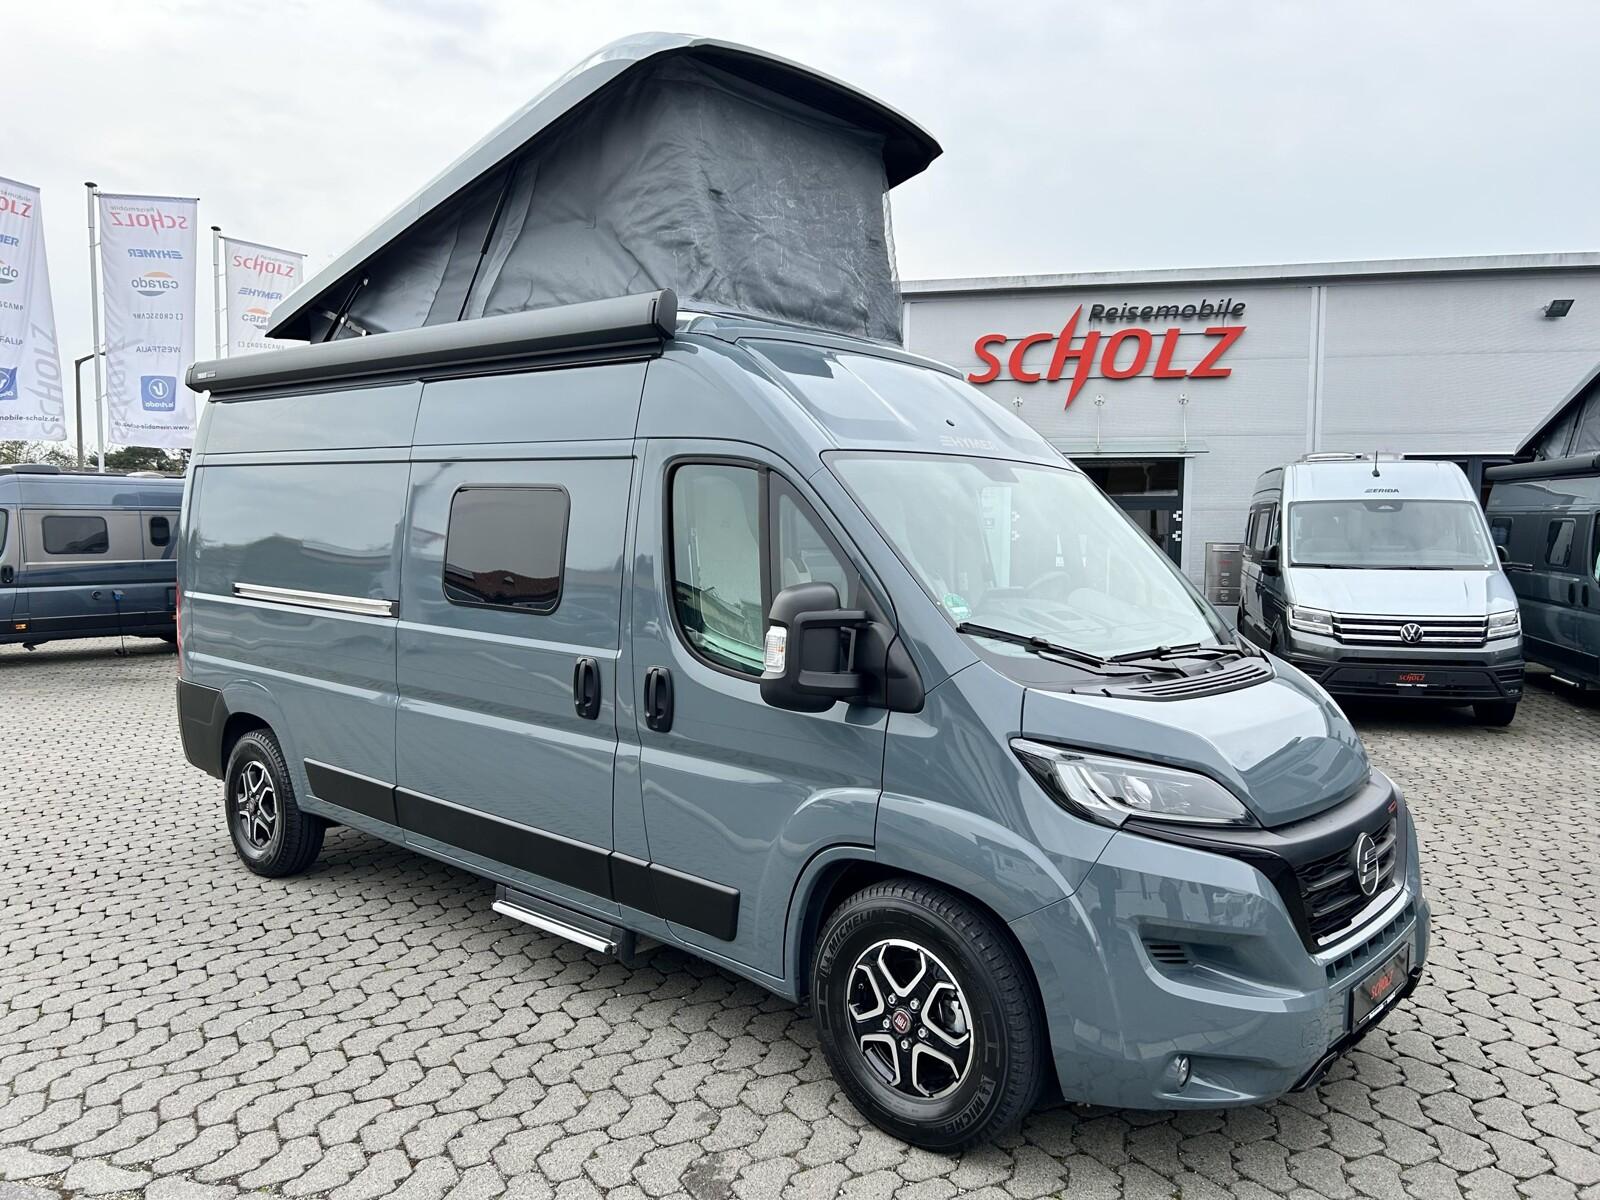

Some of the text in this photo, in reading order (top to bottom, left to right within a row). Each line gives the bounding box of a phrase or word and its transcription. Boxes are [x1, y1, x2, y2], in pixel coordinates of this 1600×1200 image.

[233, 253, 295, 278] SCHOLZ
[248, 288, 283, 300] HYMER
[241, 313, 267, 324] cara
[1089, 298, 1246, 322] Reisemobile
[967, 303, 1247, 411] SCHOLZ
[1399, 673, 1425, 682] SCHOLZ
